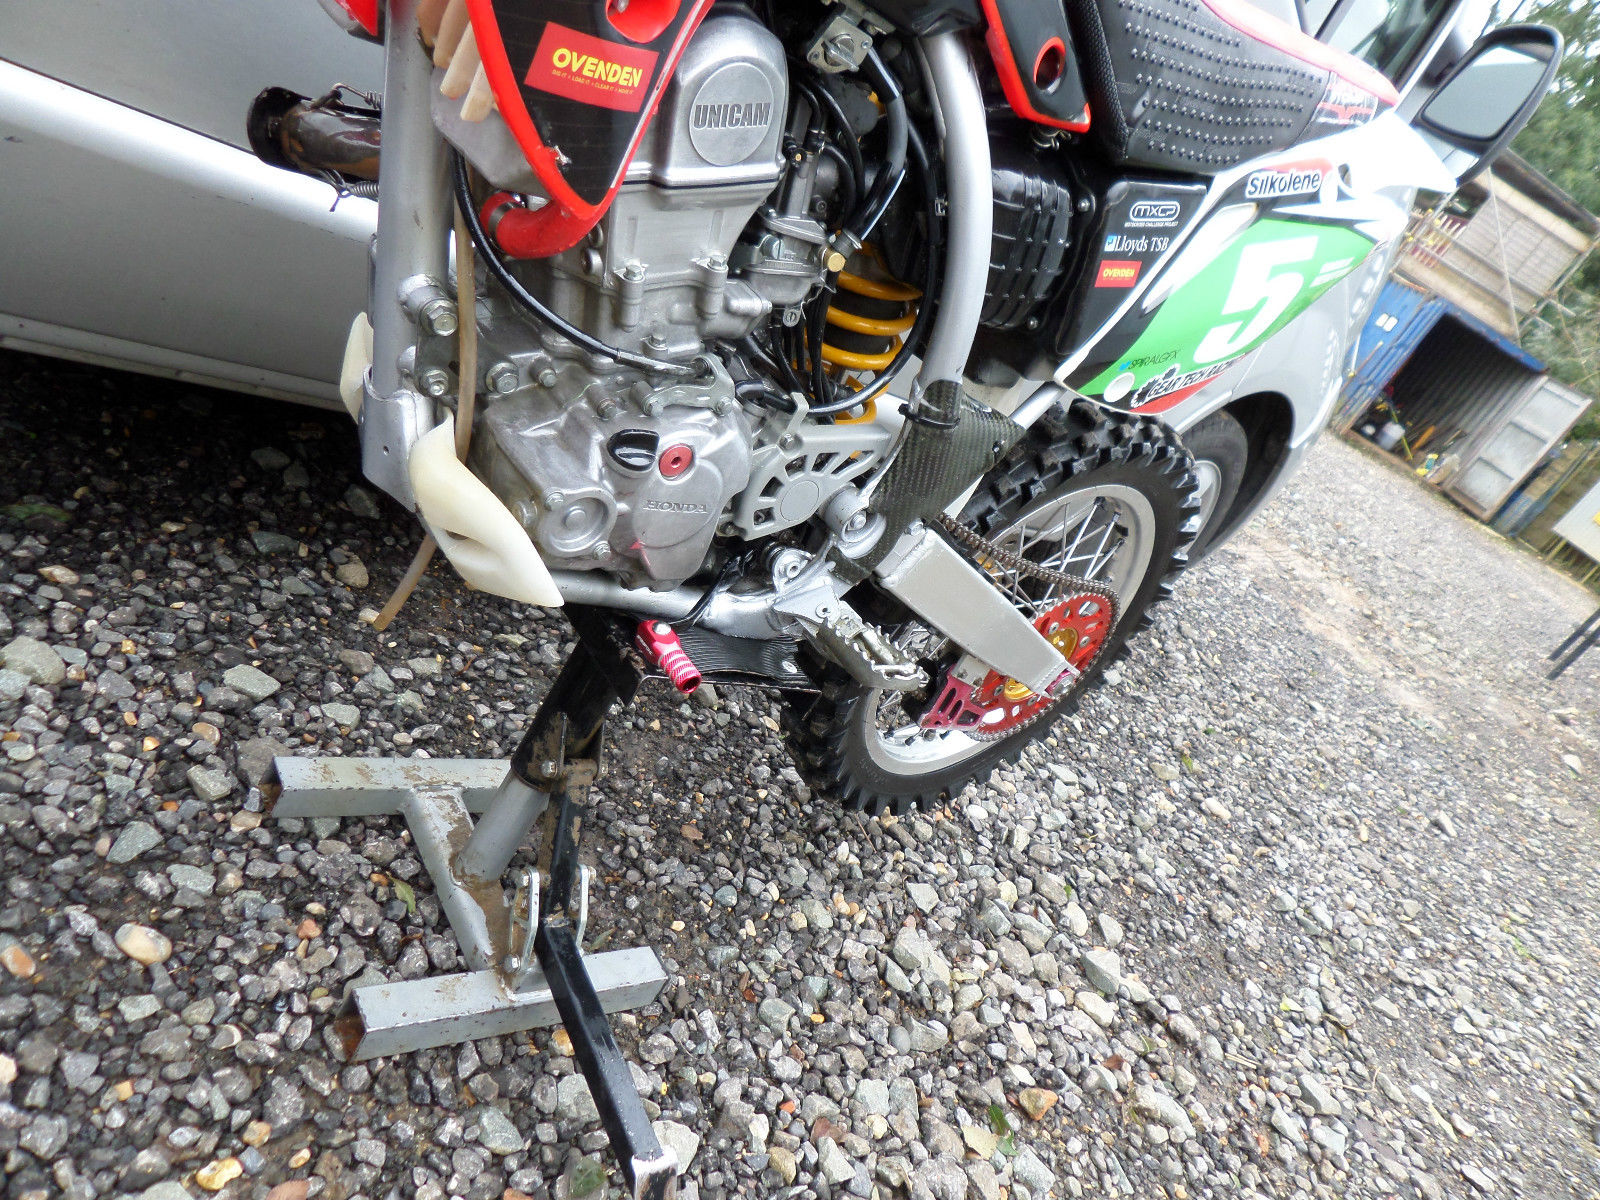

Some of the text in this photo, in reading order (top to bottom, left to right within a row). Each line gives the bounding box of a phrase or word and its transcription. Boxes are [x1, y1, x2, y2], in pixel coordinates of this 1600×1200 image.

[552, 47, 643, 88] OVENDEN
[693, 102, 771, 129] UNICAM
[1247, 172, 1321, 196] Silkolene
[1114, 235, 1170, 257] Lloyds TSB
[1102, 268, 1136, 278] OVENDEN
[1192, 234, 1320, 364] 5
[1148, 377, 1181, 398] GEAR
[1179, 369, 1210, 388] TECH
[643, 499, 708, 513] HONDA
